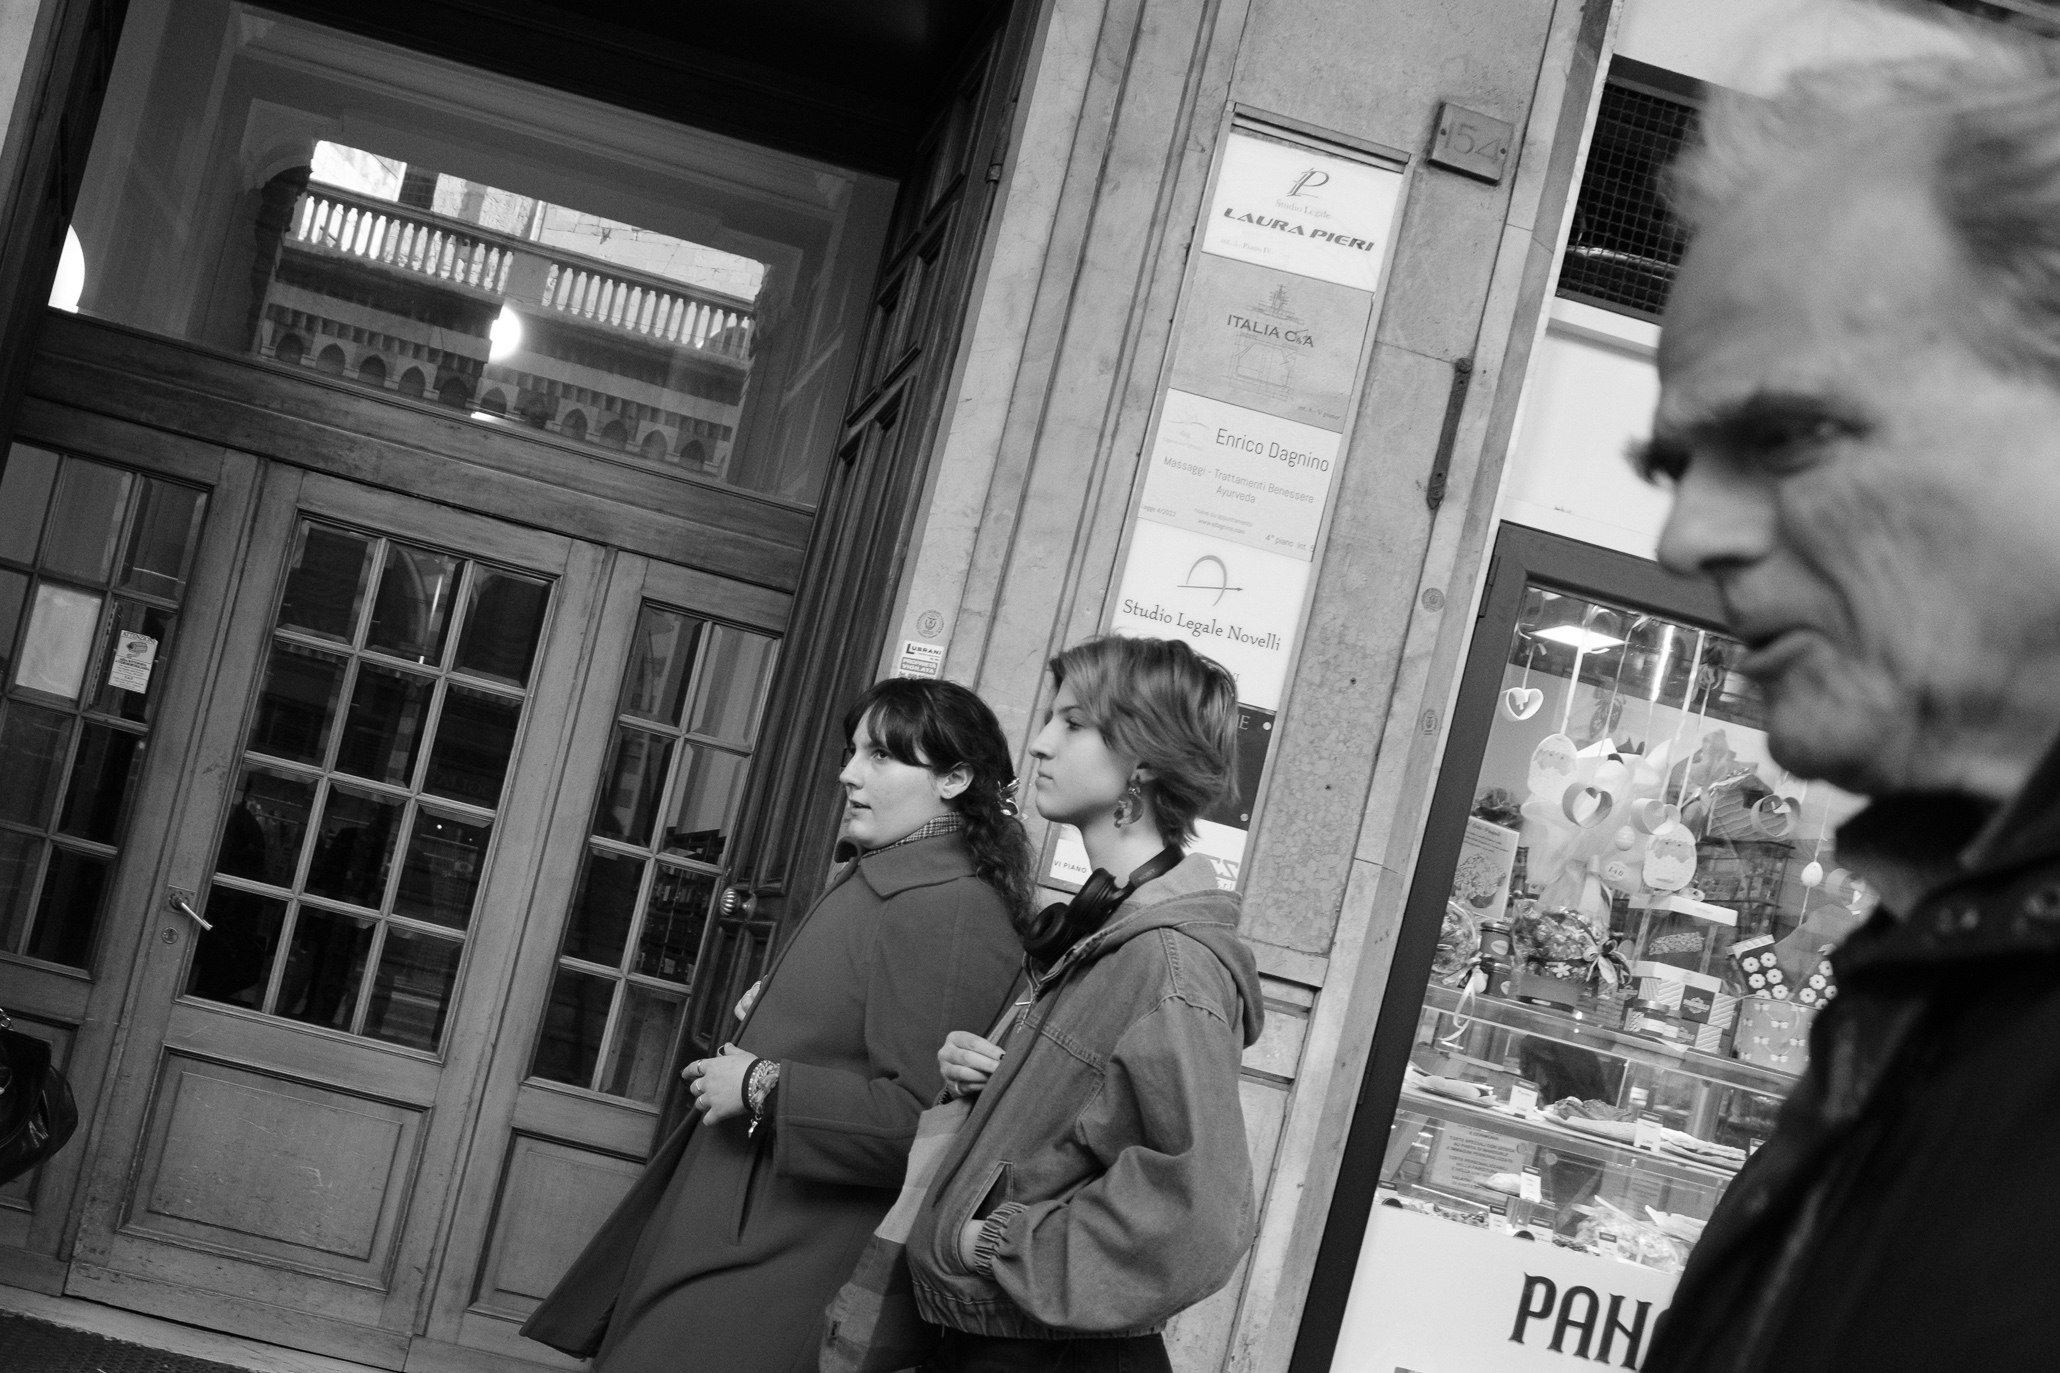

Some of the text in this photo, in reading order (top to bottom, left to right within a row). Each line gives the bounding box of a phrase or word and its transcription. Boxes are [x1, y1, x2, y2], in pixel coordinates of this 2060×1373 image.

[1276, 199, 1332, 220] Studio Legale
[1223, 207, 1375, 252] LAURA PIERI
[1227, 314, 1280, 339] ITALIA
[1216, 428, 1264, 455] Enrico
[1268, 441, 1330, 472] Dagnino
[1163, 456, 1206, 477] Massaggi
[1214, 468, 1266, 491] Trattamenti
[1268, 482, 1315, 504] Benessere
[1216, 485, 1256, 504] Ayurveda
[1275, 536, 1294, 547] piano
[1122, 599, 1282, 651] Studio Legale Novelli
[906, 643, 942, 656] LUBRANI
[902, 664, 934, 674] VIGILATA
[1054, 860, 1087, 874] VI PIANO
[1507, 1271, 1654, 1372] PAN
